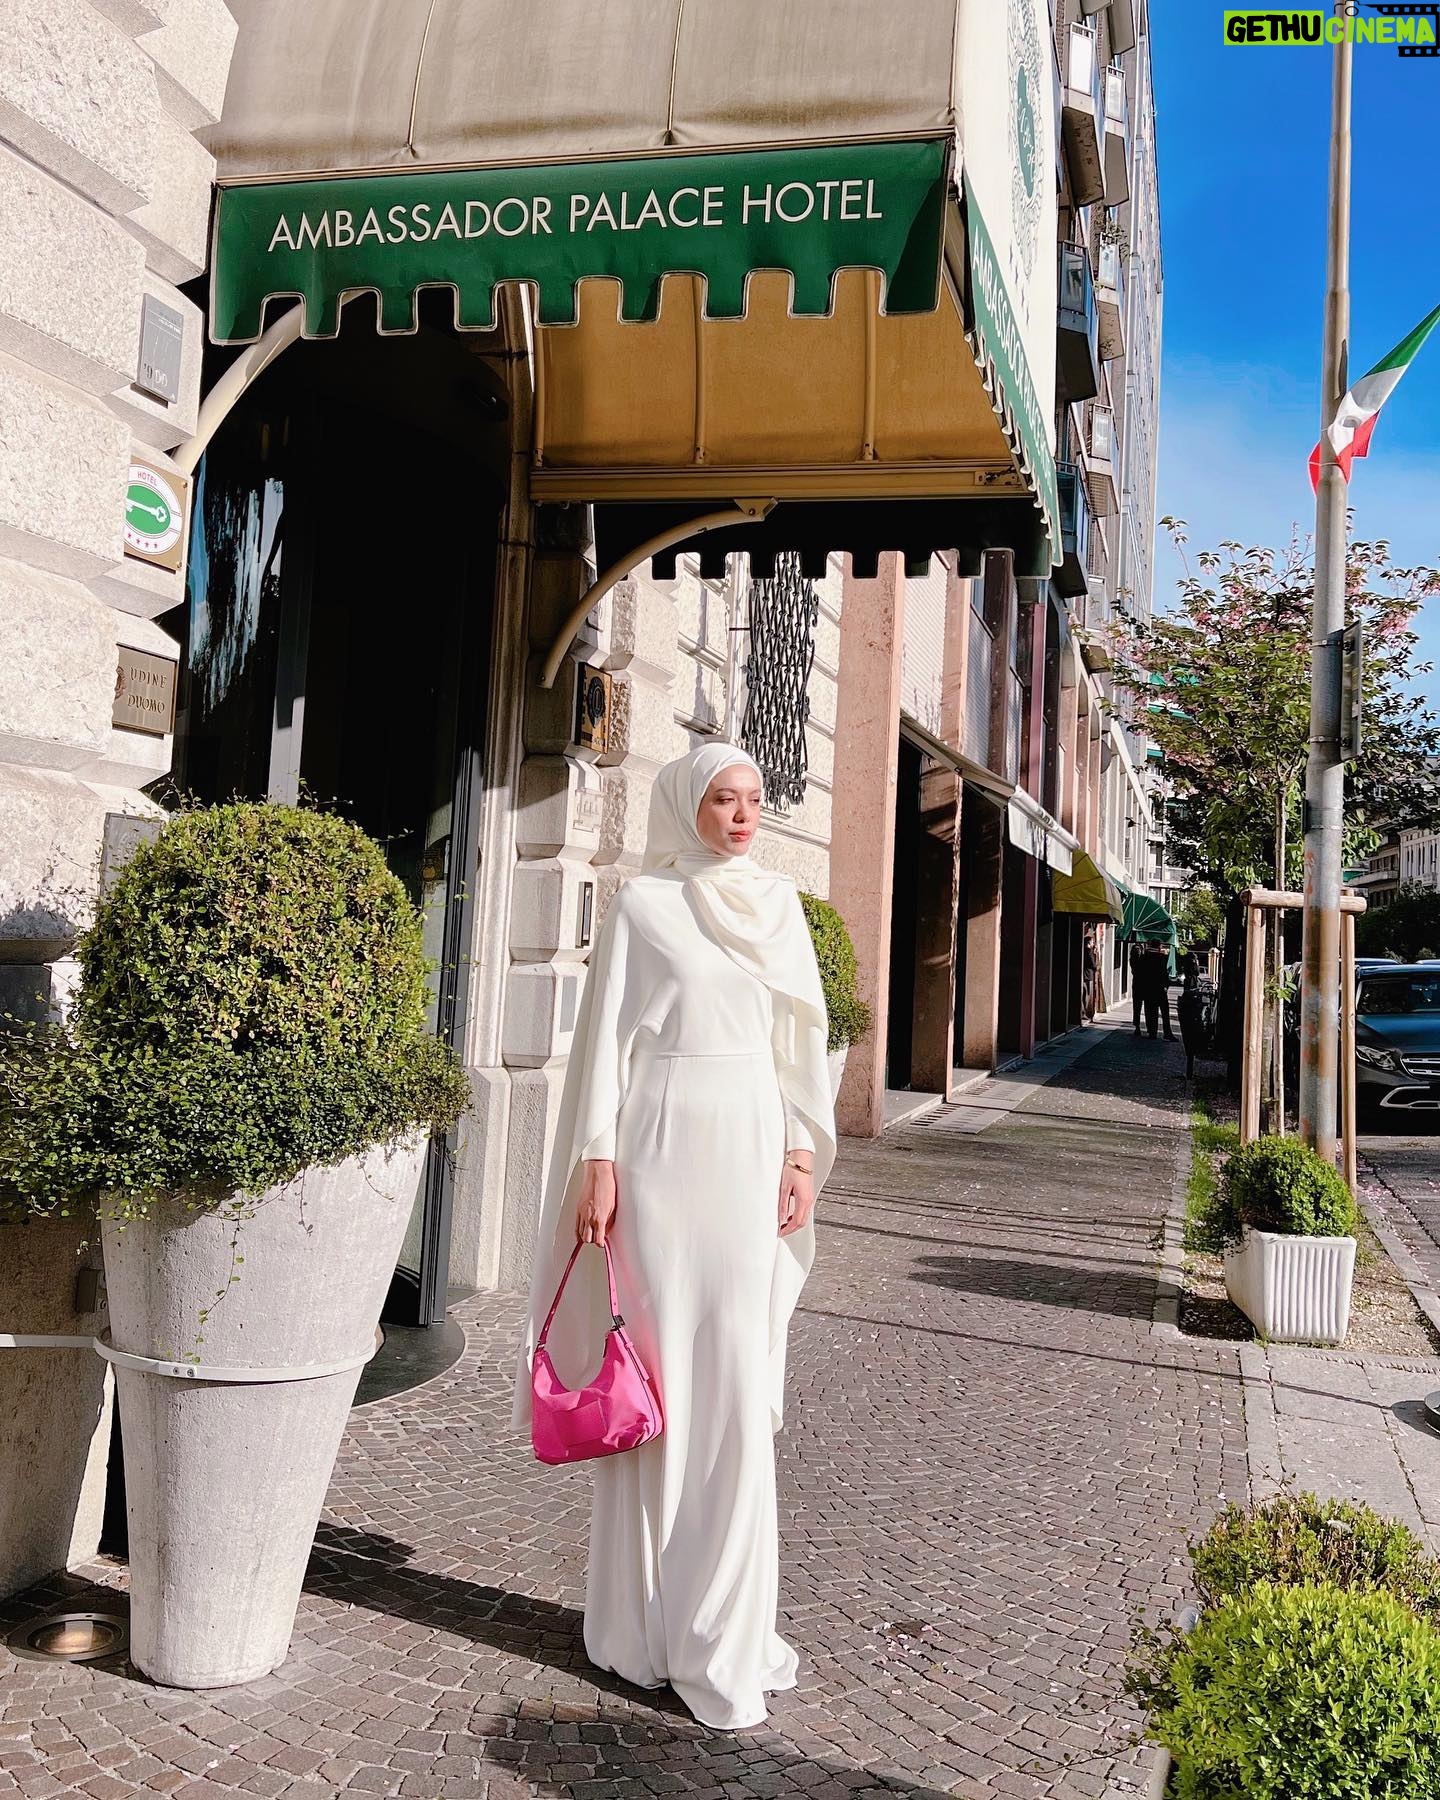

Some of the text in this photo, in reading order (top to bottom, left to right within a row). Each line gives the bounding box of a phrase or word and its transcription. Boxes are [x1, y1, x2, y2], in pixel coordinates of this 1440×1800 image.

[267, 178, 883, 252] AMBASSADOR PALACE HOTEL
[973, 223, 1024, 402] AMBASSADOR
[137, 471, 157, 486] HOTEL
[130, 667, 167, 688] UDINE
[127, 693, 165, 714] DUOMO
